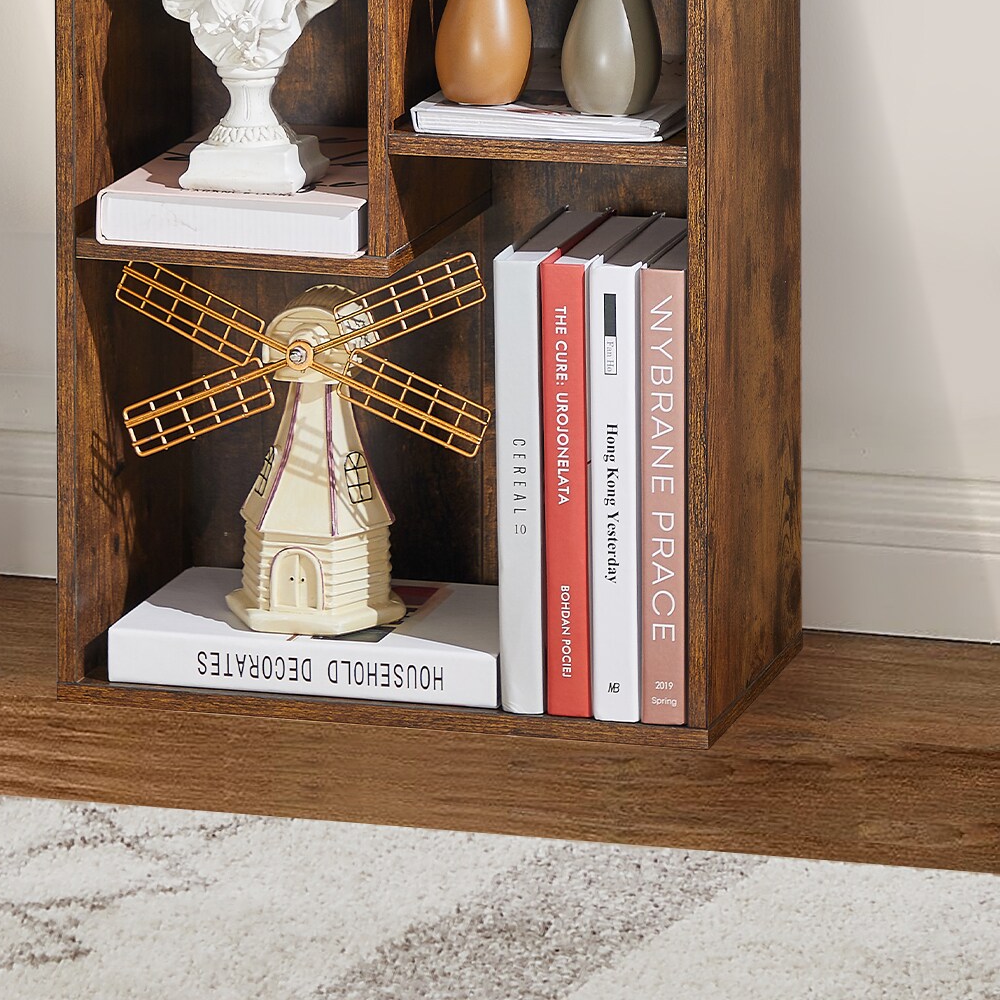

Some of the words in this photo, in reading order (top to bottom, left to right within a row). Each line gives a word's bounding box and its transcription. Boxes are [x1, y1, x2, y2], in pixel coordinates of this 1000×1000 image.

[554, 306, 567, 335] THE
[555, 340, 568, 386] CURE:
[650, 295, 674, 494] WYBRANE
[556, 393, 570, 505] UROJONELATA
[603, 424, 619, 463] Hong
[512, 438, 527, 514] CEREAL
[604, 468, 619, 506] Kong
[514, 524, 527, 534] 10
[604, 511, 620, 584] Yesterday
[651, 512, 676, 642] PRACE
[560, 585, 571, 635] BOHDAN
[197, 651, 312, 682] DECORATES
[327, 659, 444, 691] HOUSEHOLD
[561, 639, 572, 678] POCIEJ
[651, 696, 678, 707] Spring
[655, 681, 674, 690] 2019
